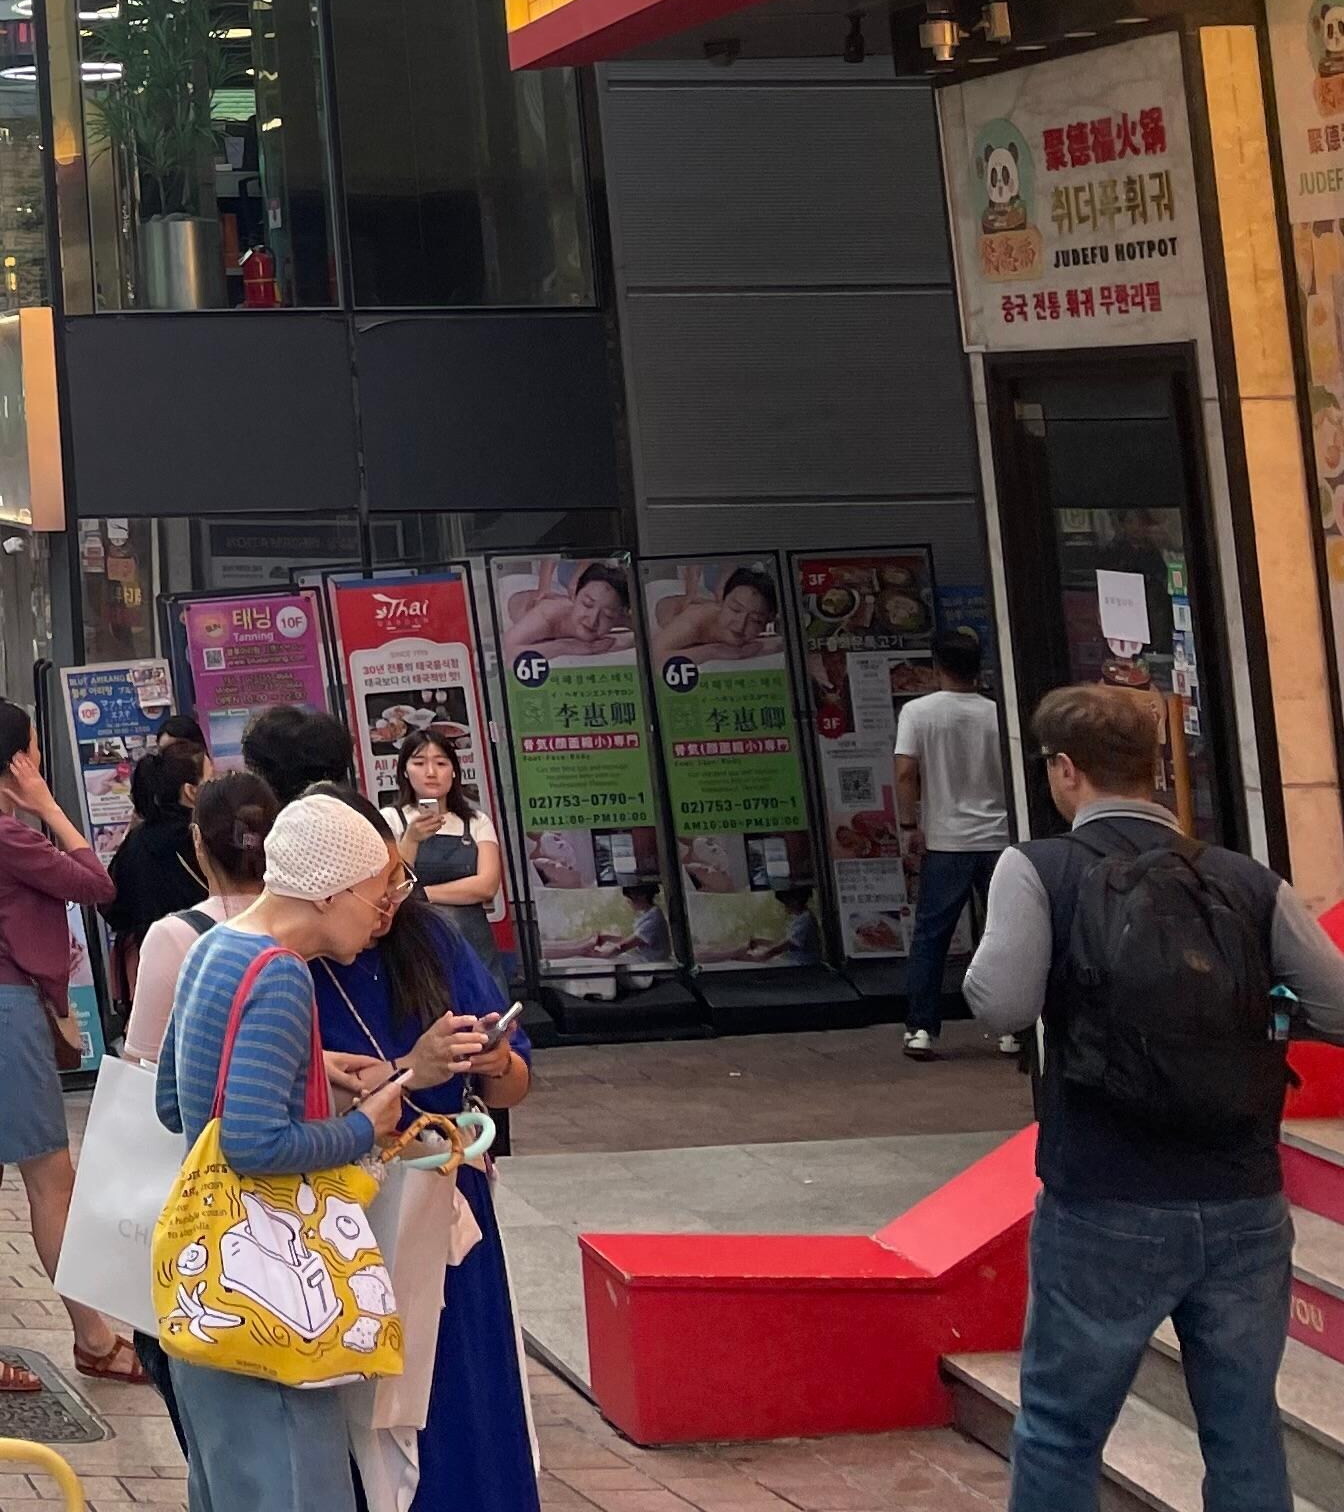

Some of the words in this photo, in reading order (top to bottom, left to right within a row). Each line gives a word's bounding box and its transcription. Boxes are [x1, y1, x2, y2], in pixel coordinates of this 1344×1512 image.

[1299, 168, 1344, 197] JUDEF
[1054, 245, 1109, 269] JUDEFU
[1115, 237, 1177, 262] HOTPOT
[1001, 294, 1028, 323] 중국
[1032, 291, 1060, 321] 전통
[1099, 281, 1162, 316] 무한리필
[808, 573, 827, 586] 3F
[232, 606, 272, 630] 태닝
[372, 594, 430, 619] Thai
[280, 616, 304, 629] 10F
[233, 631, 274, 643] Tanning
[516, 658, 547, 681] 6F
[666, 663, 696, 686] 6F
[823, 717, 841, 730] 3F
[375, 759, 388, 770] All
[528, 791, 645, 809] 02)753-0790-1
